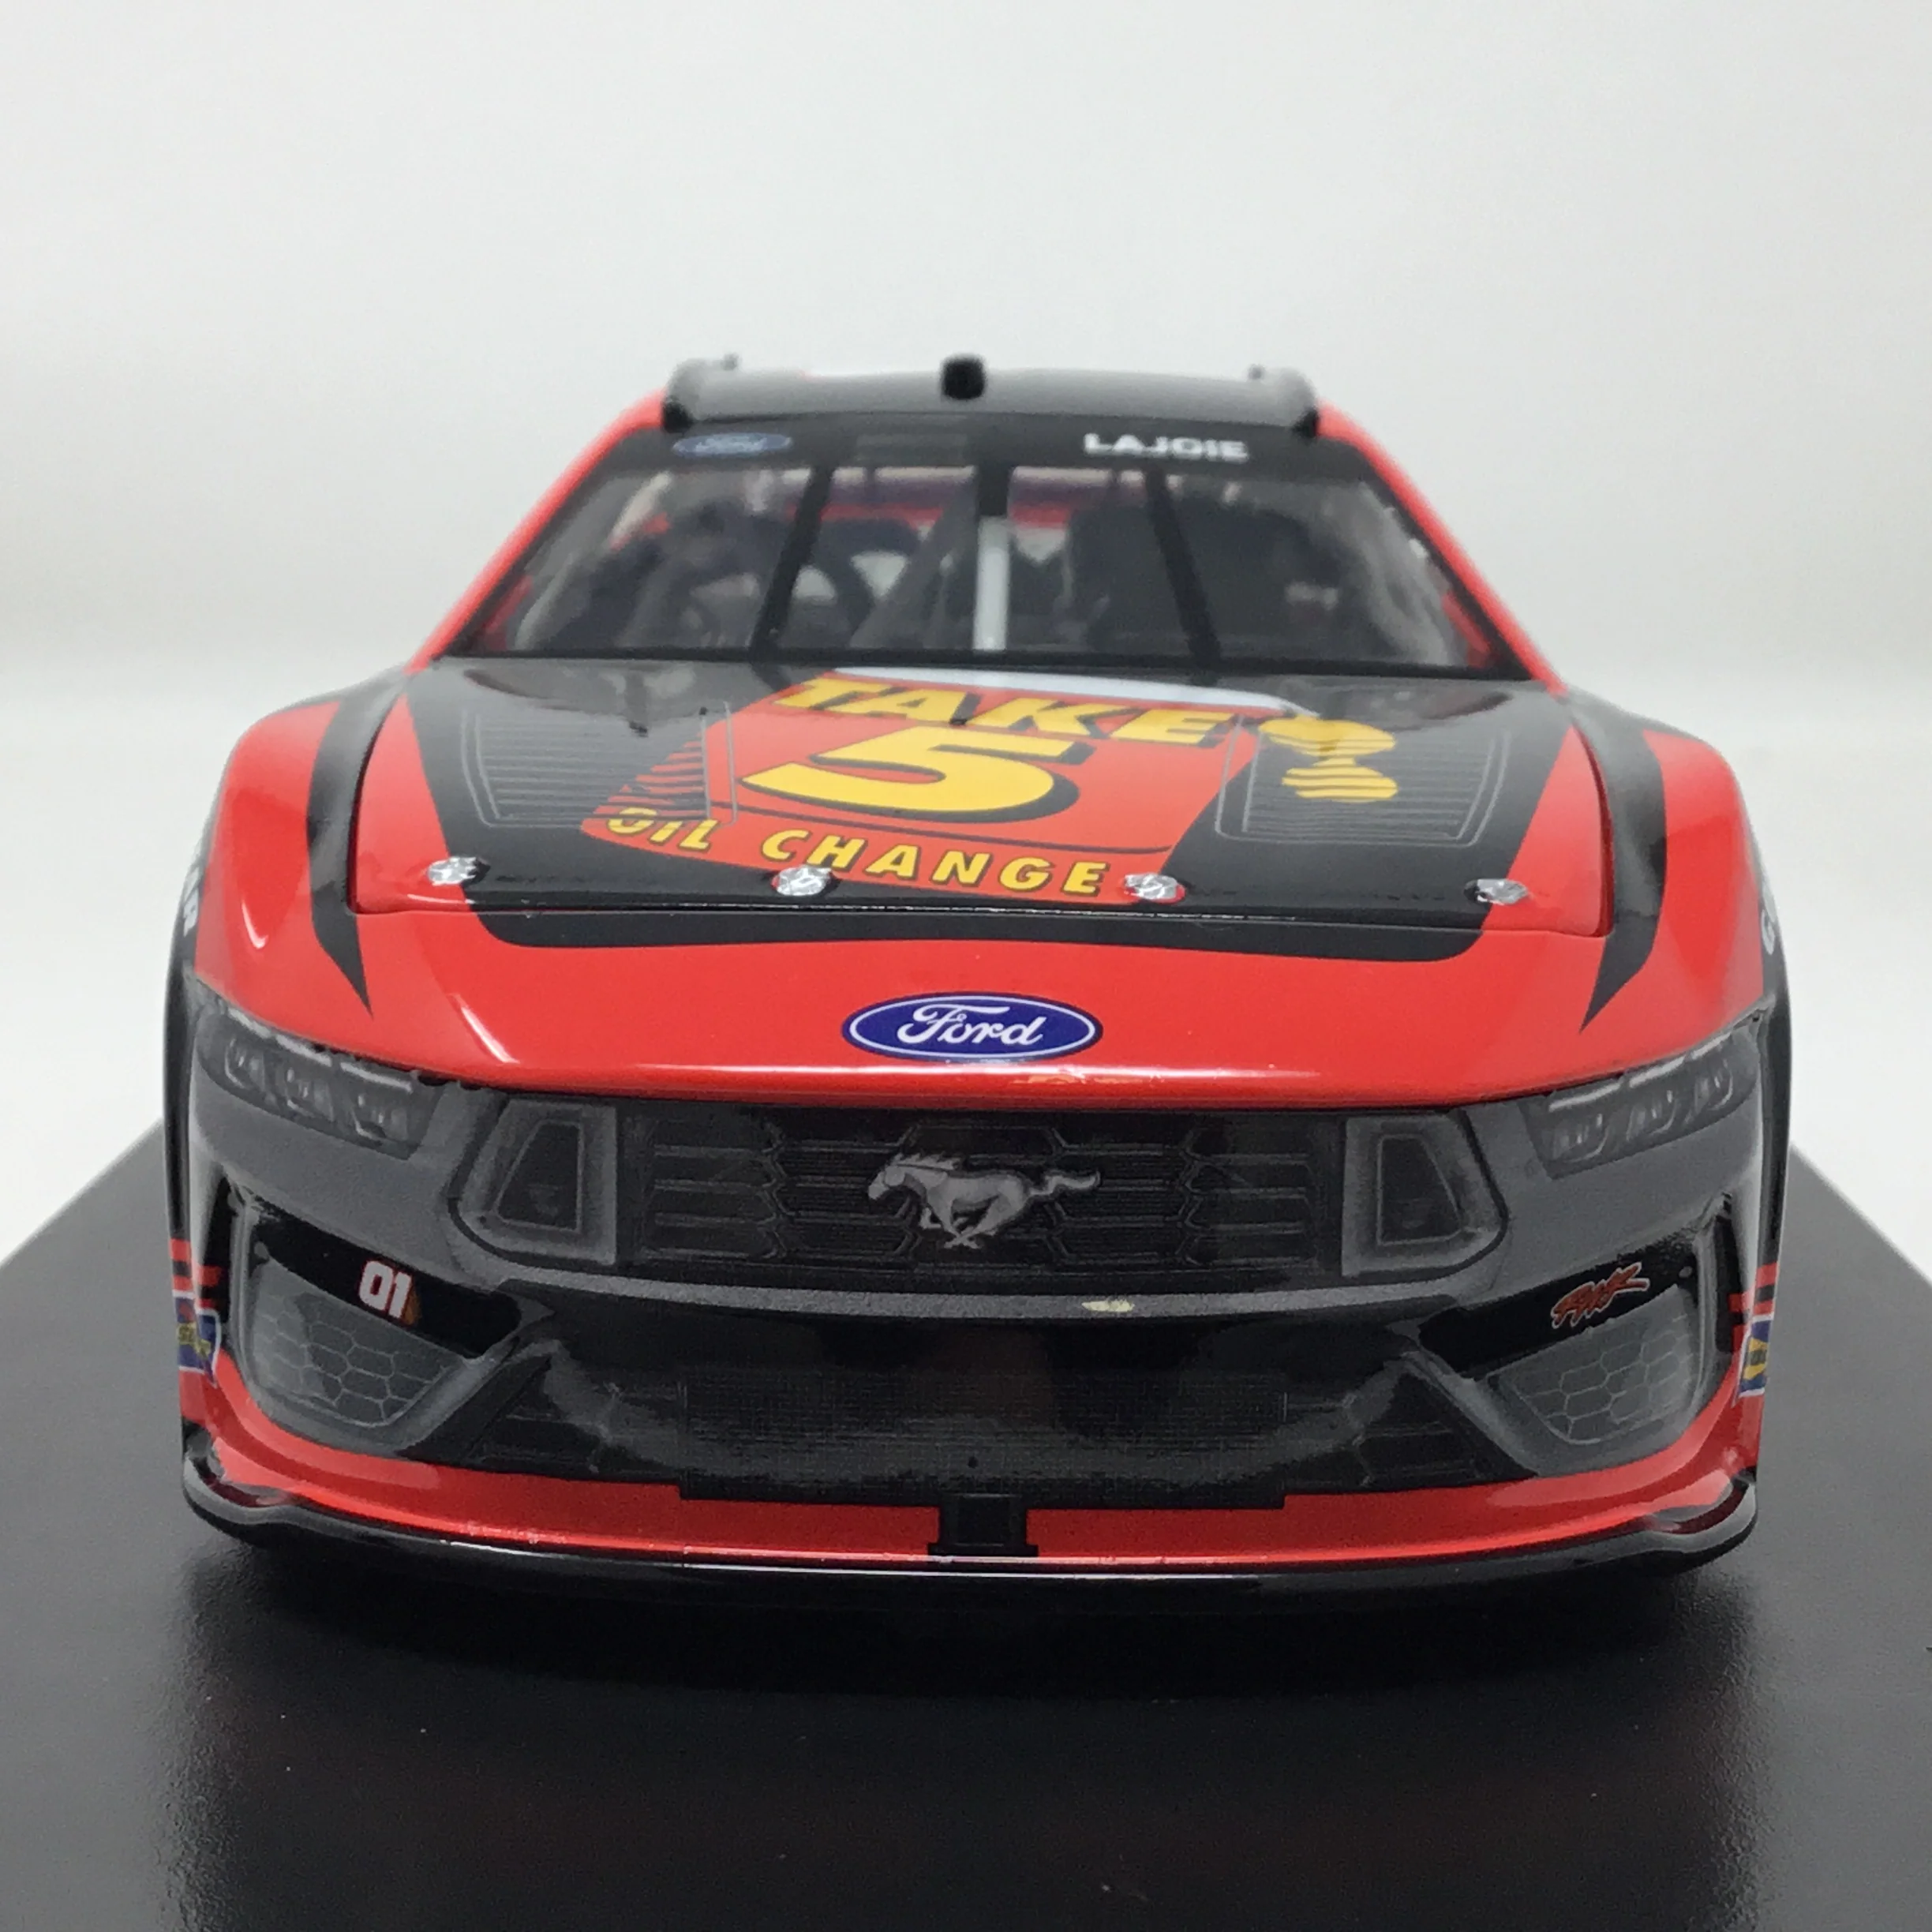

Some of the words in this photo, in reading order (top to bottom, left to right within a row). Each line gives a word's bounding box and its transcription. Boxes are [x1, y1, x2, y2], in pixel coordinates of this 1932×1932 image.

[1084, 432, 1249, 464] LAJOIE
[772, 676, 1234, 747] TAKE
[740, 725, 1069, 819] 5
[607, 807, 719, 852] OIL
[761, 829, 1108, 896] CHANGE
[897, 1003, 1046, 1046] Ford
[358, 1260, 412, 1319] 01
